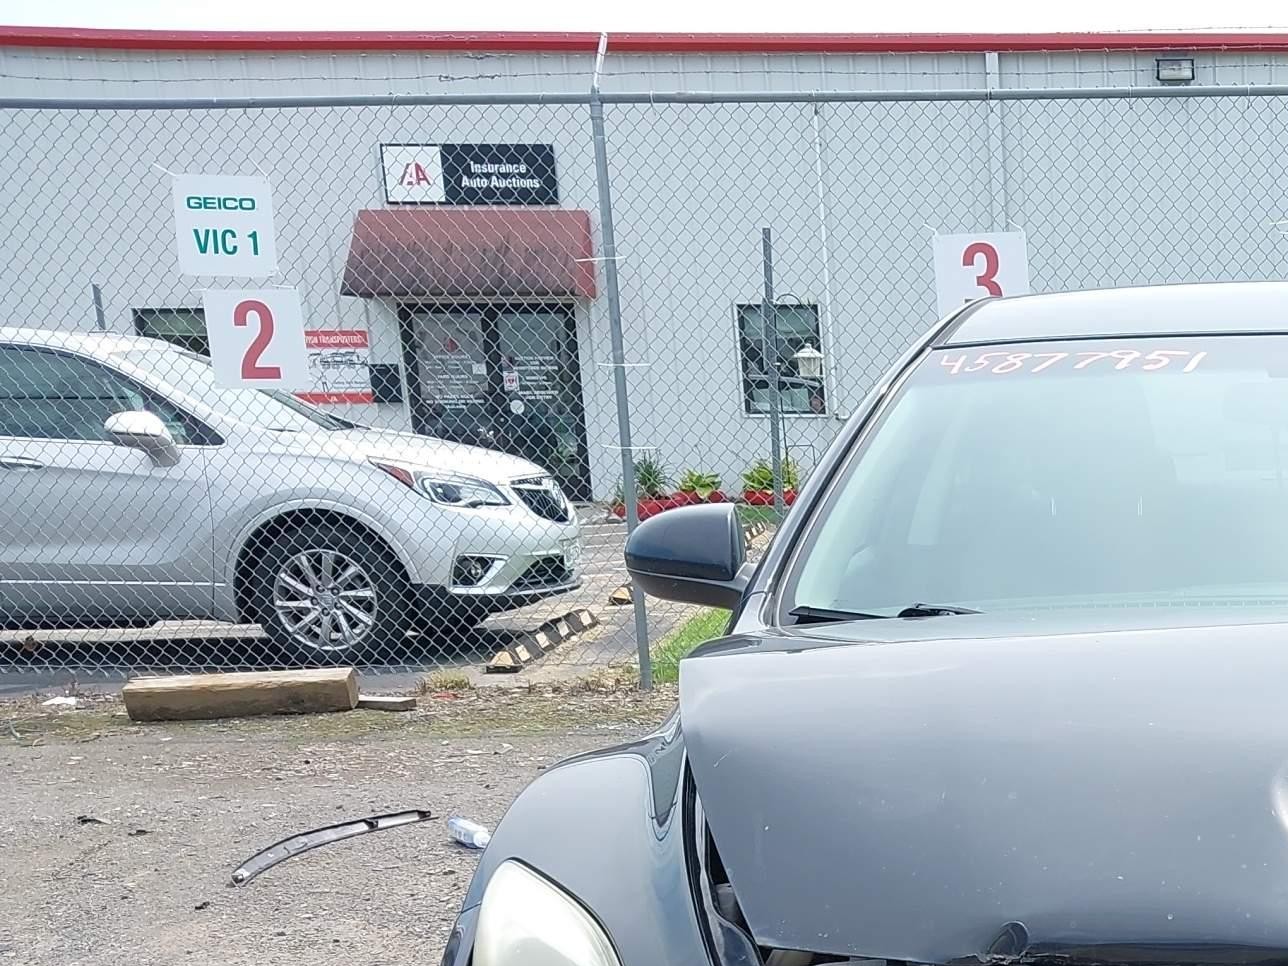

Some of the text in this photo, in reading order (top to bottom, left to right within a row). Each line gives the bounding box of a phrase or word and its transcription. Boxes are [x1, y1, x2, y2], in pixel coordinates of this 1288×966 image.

[471, 161, 527, 173] Insurance
[461, 175, 541, 188] Auto Auctions
[186, 196, 256, 210] GEICO
[193, 229, 259, 255] VIC 1
[962, 242, 1003, 303] 3
[233, 300, 282, 379] 2
[940, 350, 1208, 374] 45877951
